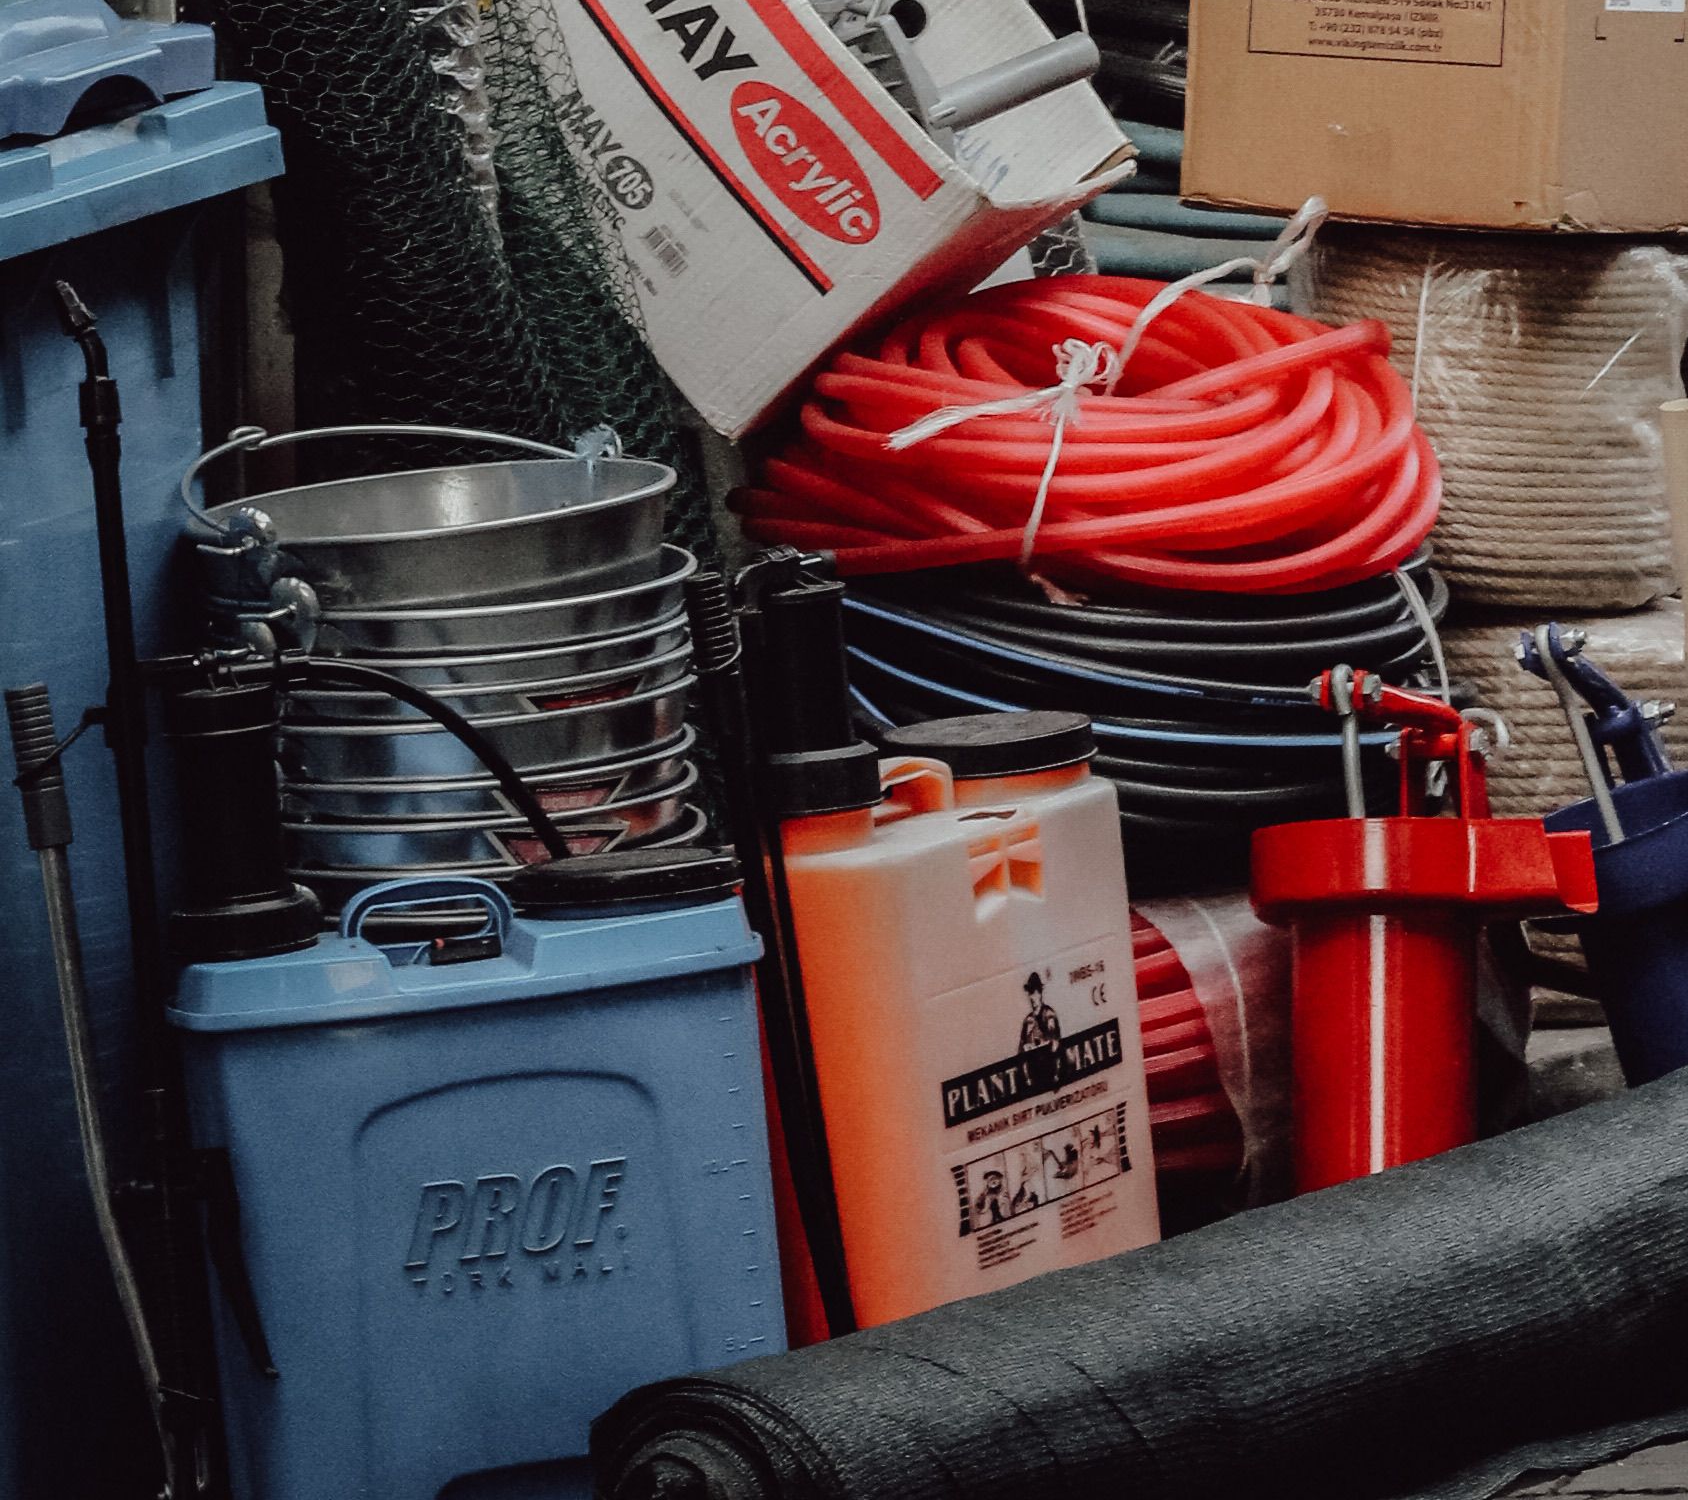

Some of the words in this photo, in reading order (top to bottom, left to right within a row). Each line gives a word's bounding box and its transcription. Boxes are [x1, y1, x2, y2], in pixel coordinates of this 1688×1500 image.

[607, 159, 652, 206] 705
[737, 97, 873, 238] Acrylic
[947, 1066, 1019, 1118] PLANT
[1066, 1030, 1118, 1071] MATE
[404, 1157, 627, 1269] PROF
